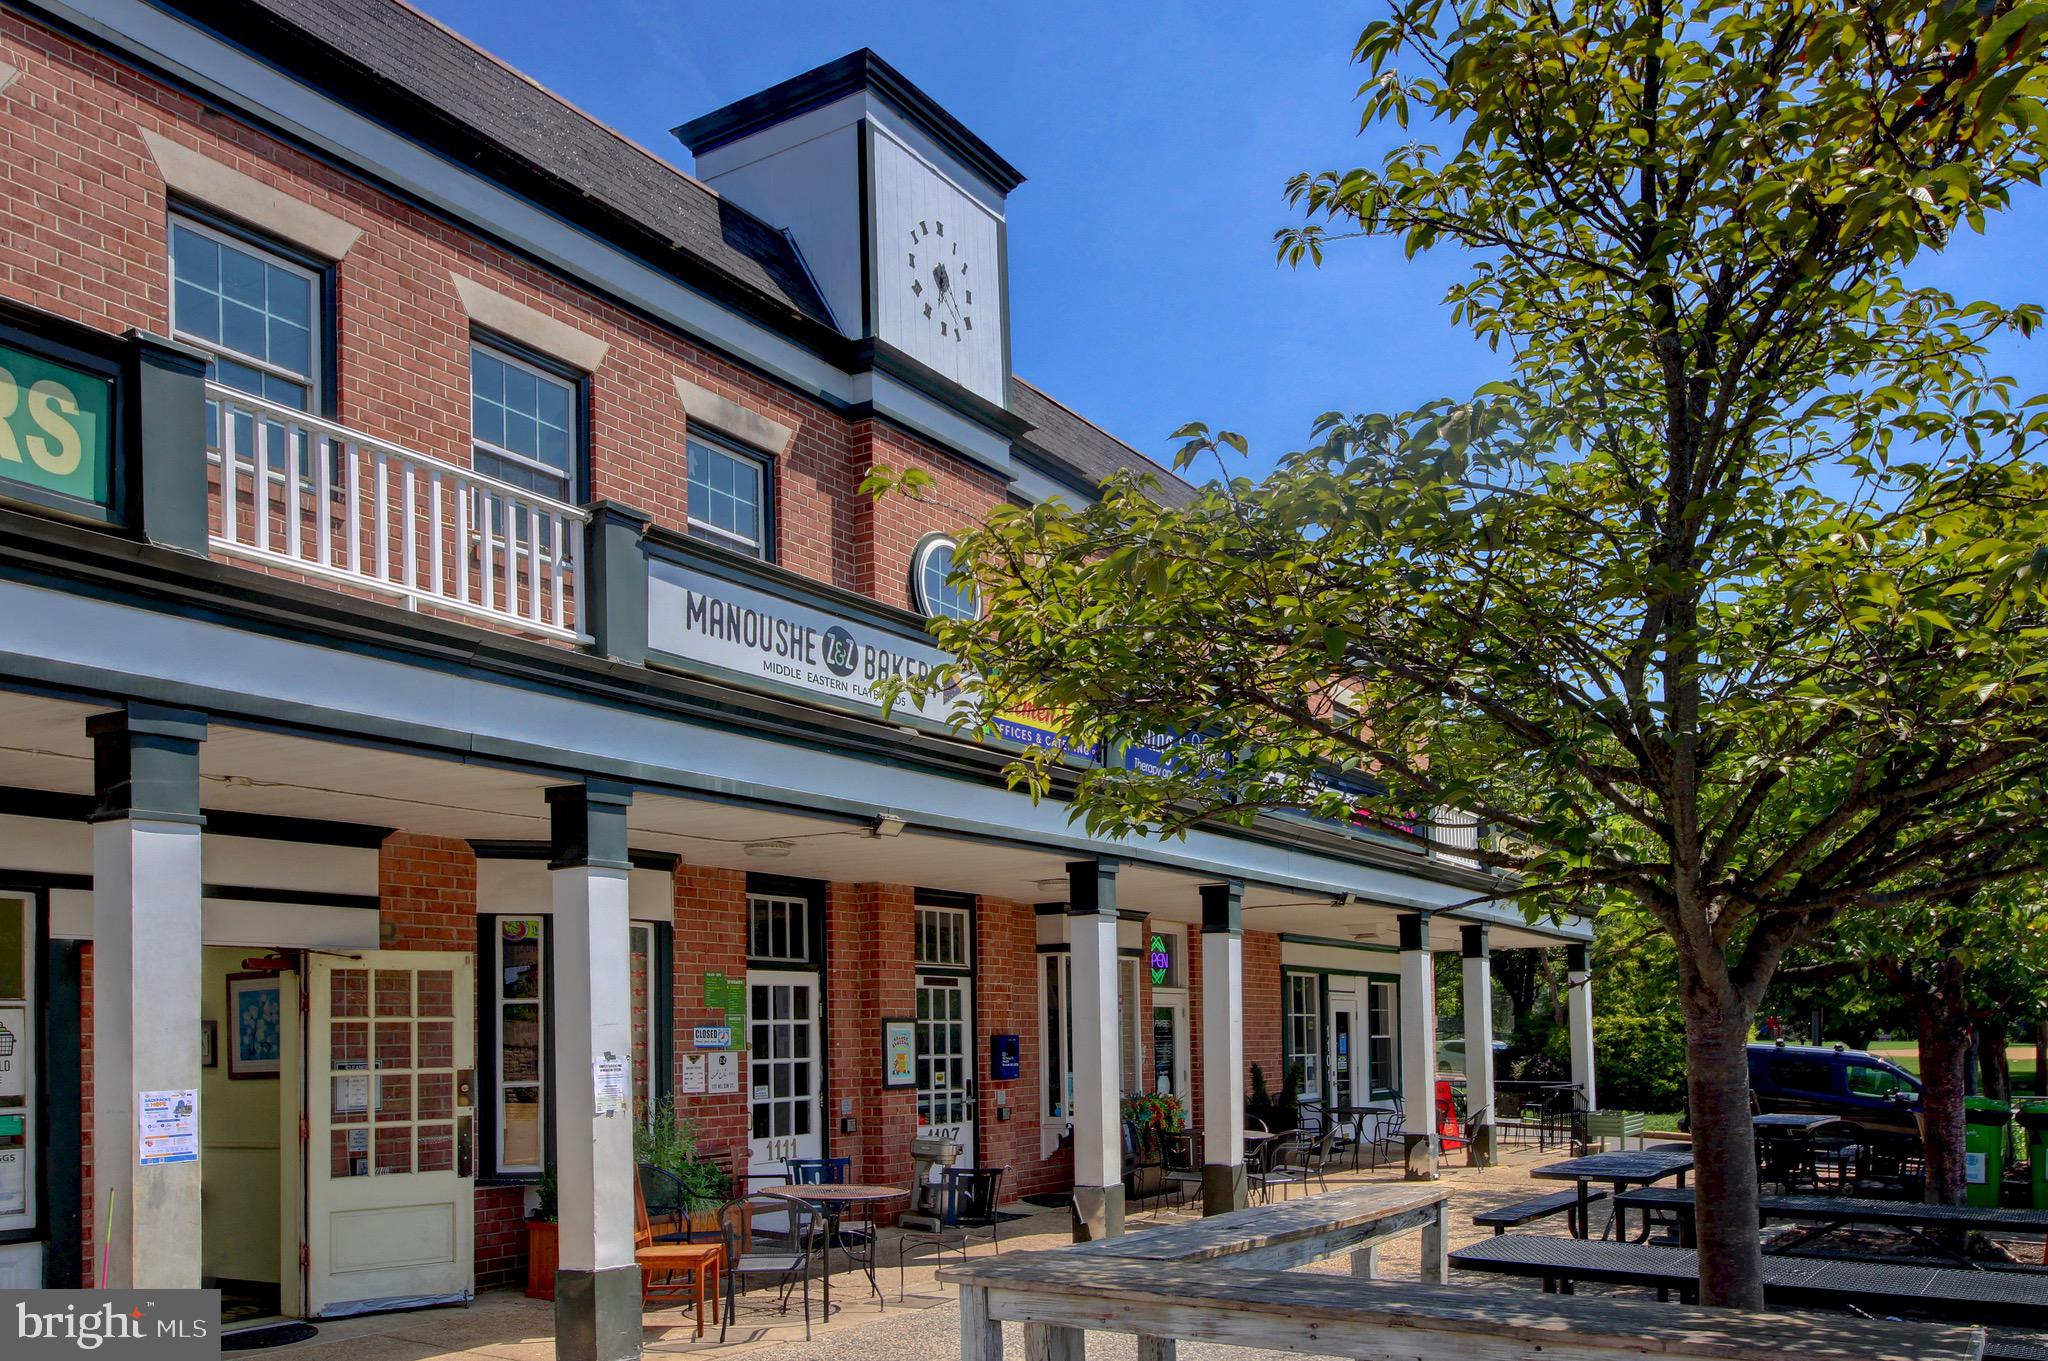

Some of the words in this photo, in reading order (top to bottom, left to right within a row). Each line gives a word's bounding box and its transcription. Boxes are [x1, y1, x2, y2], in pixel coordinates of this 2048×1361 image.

[686, 590, 817, 666] MANOUSHE
[864, 643, 940, 698] BAKER
[763, 660, 802, 680] MIDDLE
[807, 672, 848, 692] EASTERN
[852, 684, 907, 707] FLATBDS
[995, 722, 1032, 742] FFICES
[1035, 733, 1042, 744] &
[1134, 757, 1162, 776] Therapy
[1151, 953, 1169, 969] PEN
[695, 1029, 718, 1039] CLOSED
[0, 1154, 16, 1162] GS
[766, 1138, 798, 1161] 1111
